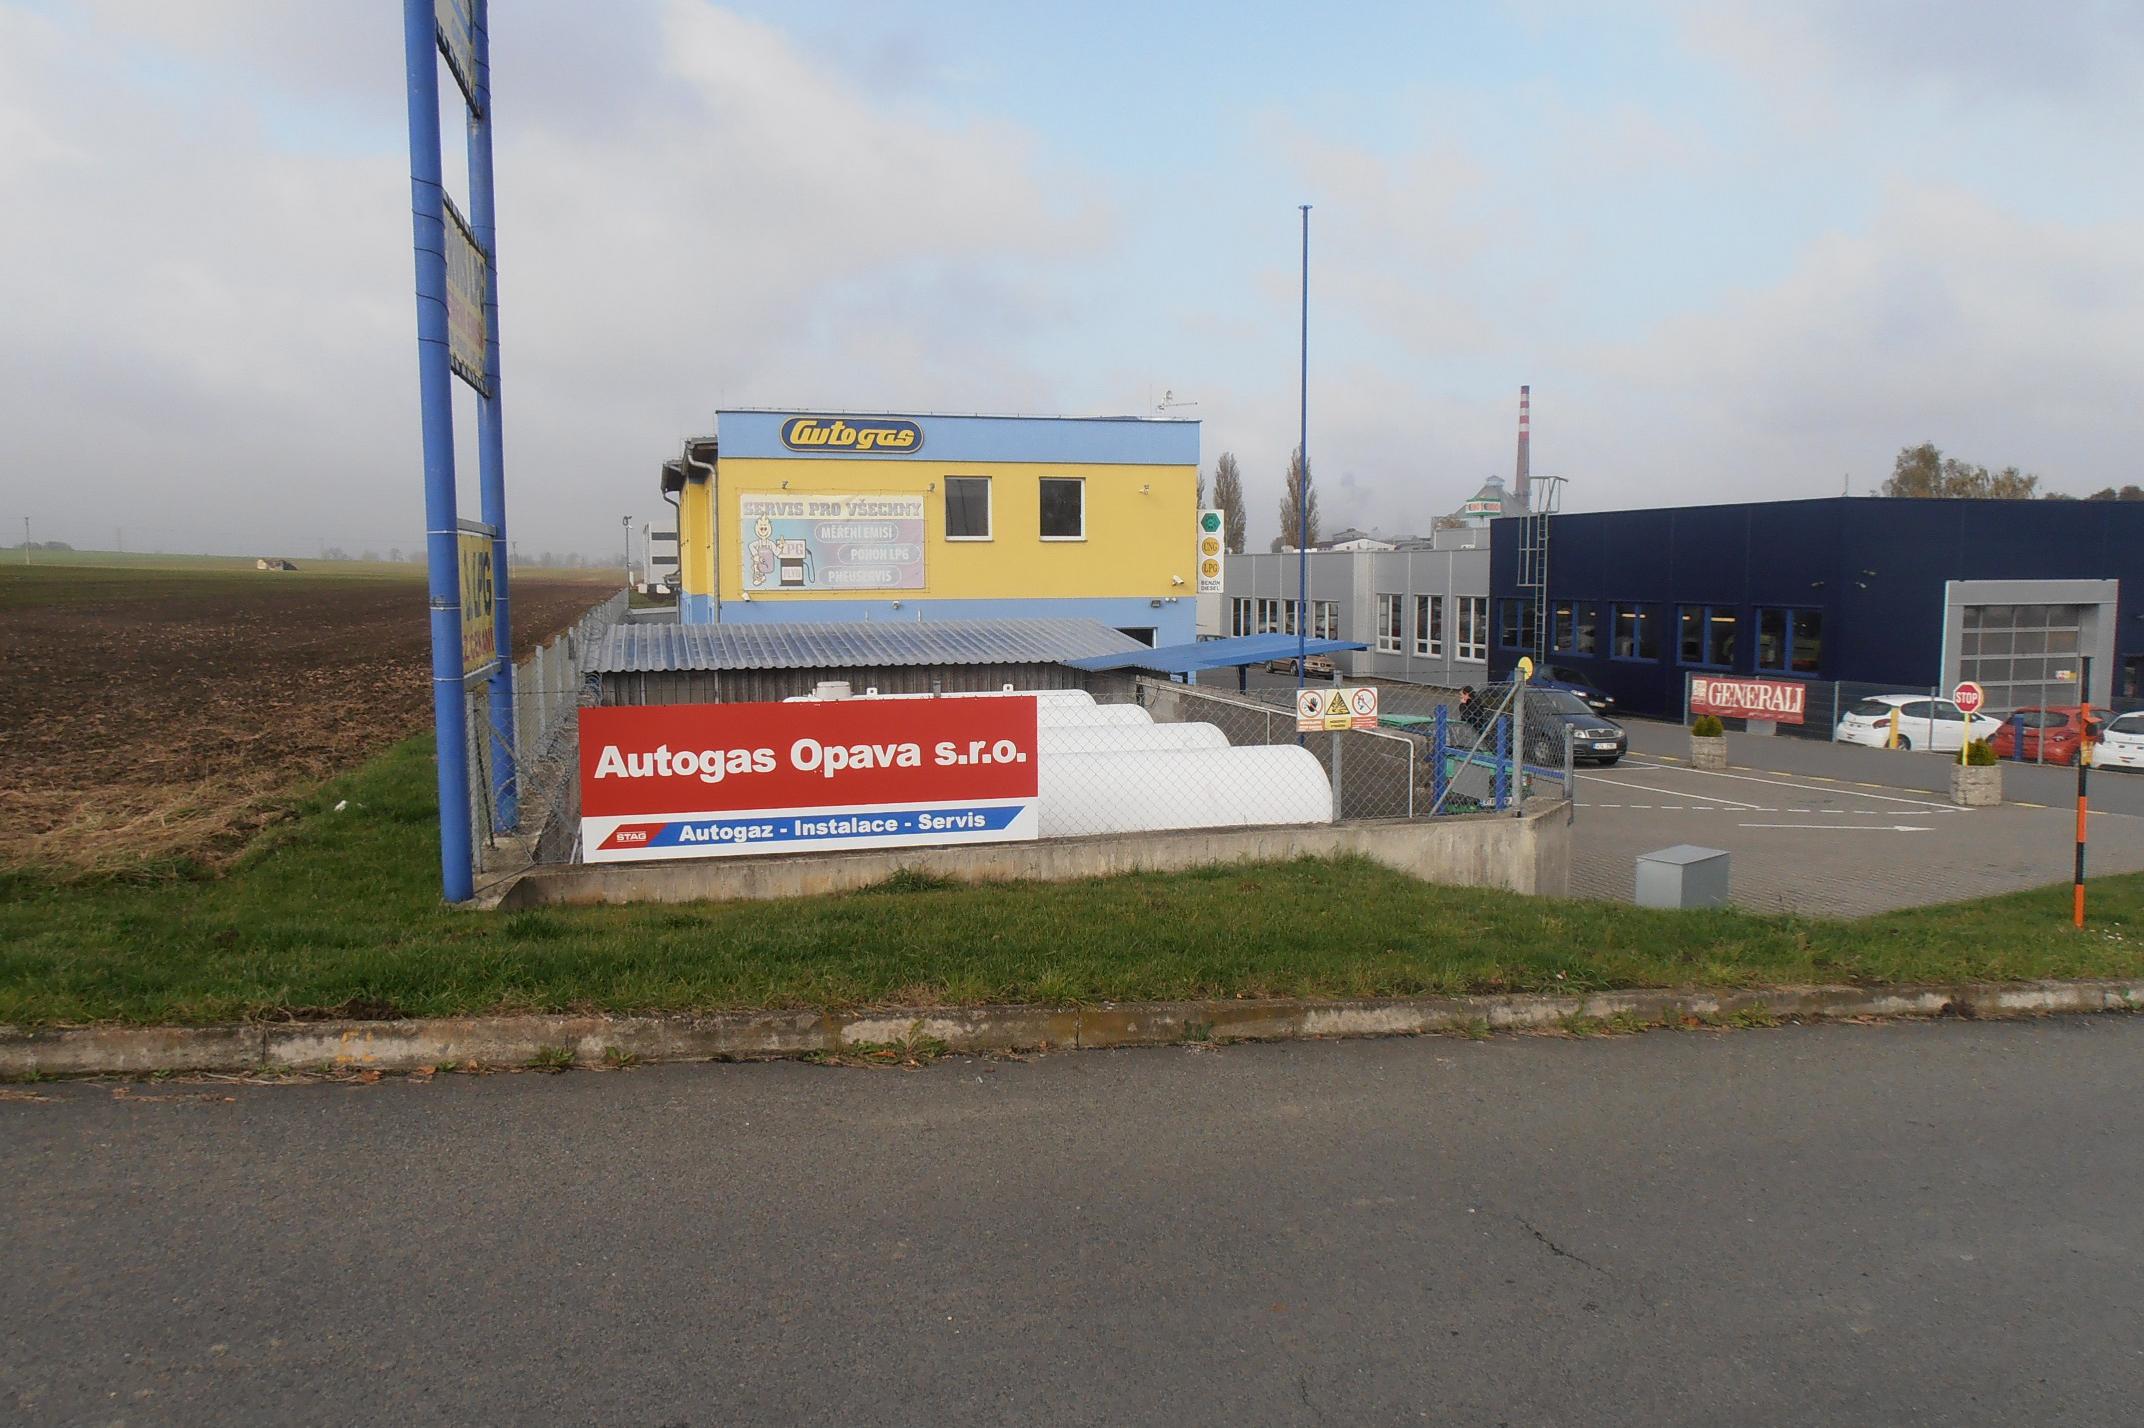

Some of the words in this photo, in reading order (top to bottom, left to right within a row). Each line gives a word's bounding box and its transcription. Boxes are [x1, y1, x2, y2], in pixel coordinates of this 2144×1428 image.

[790, 420, 915, 449] Autogas
[743, 502, 804, 516] SERVIS
[808, 502, 841, 516] PRO
[846, 499, 922, 517] VŠECHNY
[821, 525, 861, 539] MĚŘENÍ
[1203, 541, 1218, 552] CNG
[889, 549, 910, 560] LPG
[1203, 563, 1218, 573] LPG
[828, 570, 892, 583] PNEUSERVIS
[1708, 682, 1804, 713] GENERALI
[1956, 692, 1978, 705] STOP
[594, 744, 777, 783] Autogas
[790, 738, 921, 778] Opava
[935, 739, 1027, 767] s.r.o.
[679, 823, 774, 843] Autogaz
[795, 816, 898, 836] Instalace
[918, 812, 986, 831] Servis
[616, 831, 646, 843] STAG
